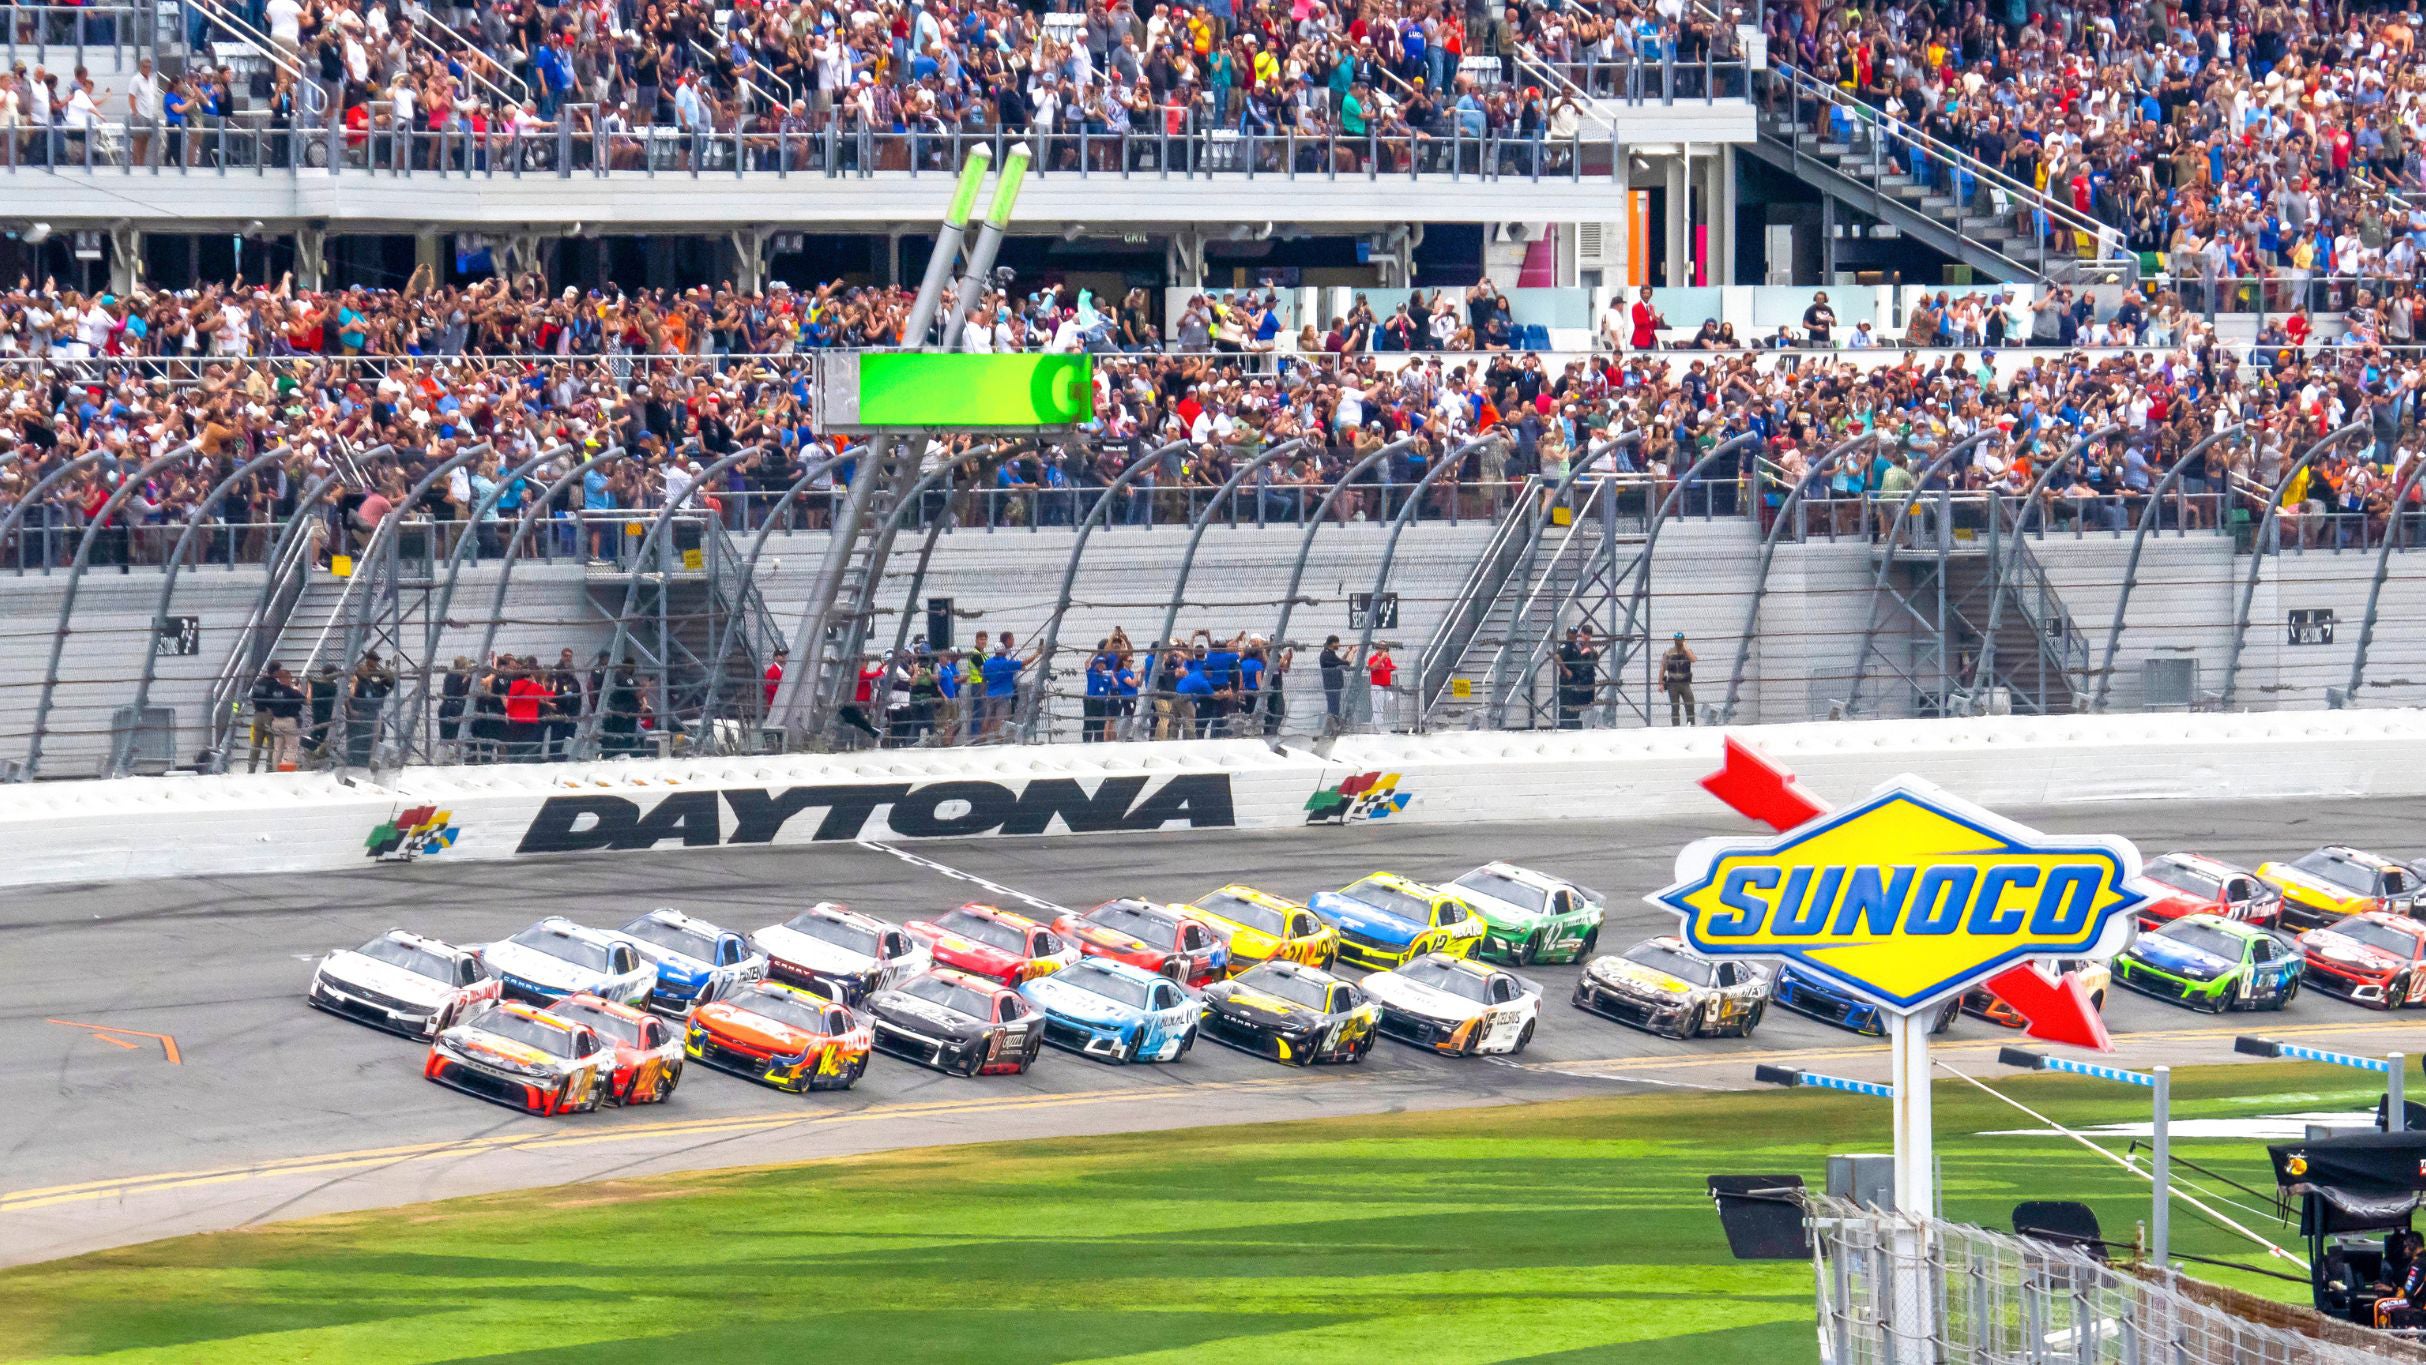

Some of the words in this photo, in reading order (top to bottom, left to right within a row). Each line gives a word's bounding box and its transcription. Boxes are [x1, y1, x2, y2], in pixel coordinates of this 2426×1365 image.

[516, 774, 1235, 854] DAYTONA
[1706, 864, 2104, 936] SUNOCO
[1543, 922, 1564, 950] 42
[773, 960, 811, 976] CAMRY
[1683, 953, 1710, 966] DILLON
[503, 975, 541, 992] CAMRY
[2240, 966, 2255, 999] 8
[1496, 1010, 1521, 1026] CELSIUS
[1706, 992, 1722, 1023] 3
[1223, 1014, 1259, 1030] CAMRY
